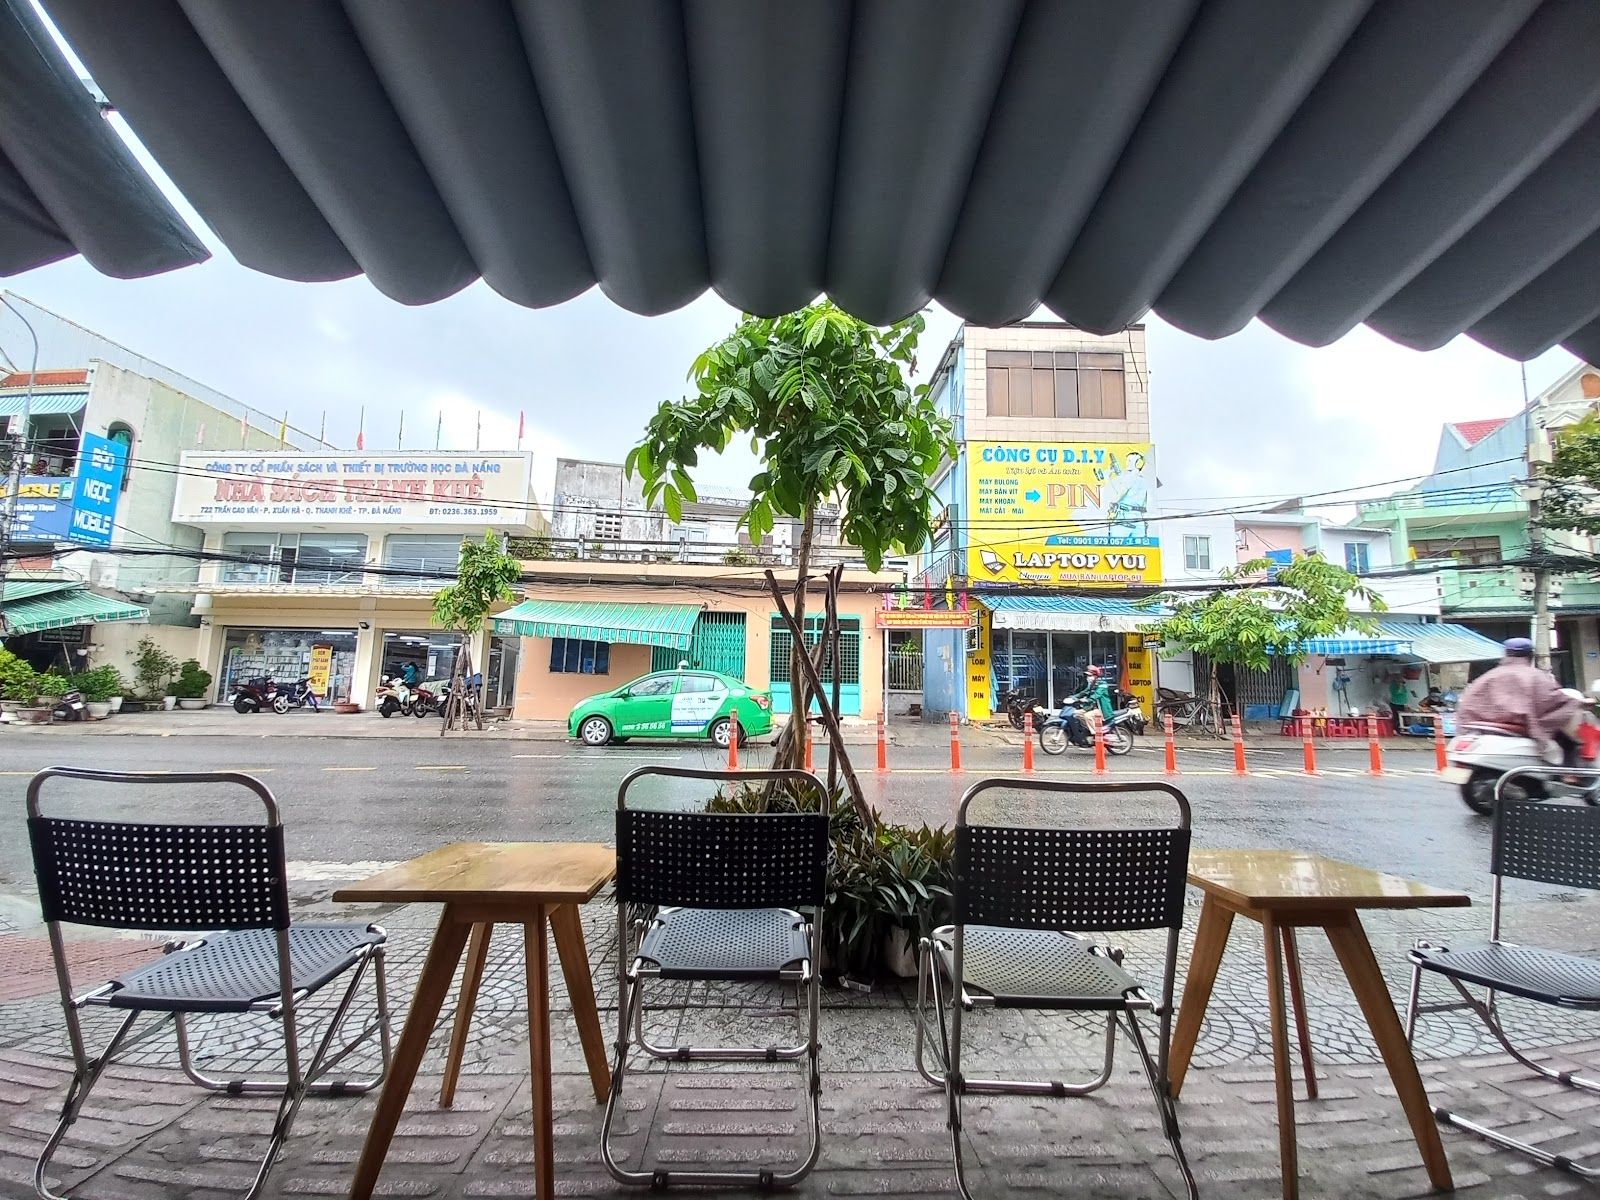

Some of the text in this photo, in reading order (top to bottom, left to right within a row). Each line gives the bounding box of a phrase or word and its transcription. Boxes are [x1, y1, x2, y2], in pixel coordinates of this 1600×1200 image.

[983, 446, 1105, 466] CÔNG CỤ D.I.Y
[205, 461, 232, 472] CÔNG
[234, 463, 247, 472] TY
[250, 459, 264, 473] CỔ
[297, 461, 323, 473] SÁCH
[326, 461, 339, 473] VÀ
[343, 460, 371, 473] THIẾT
[388, 461, 428, 473] TRƯỜNG
[430, 463, 451, 475] HỌC
[214, 473, 485, 503] NHÀ SÁCH THANH KHÊ
[1047, 483, 1102, 510] PIN
[200, 506, 213, 514] 722
[231, 506, 246, 514] CAO
[442, 508, 498, 516] 0236.363.1959
[74, 508, 113, 535] MOBILE
[1057, 537, 1072, 545] Tel:
[1072, 537, 1093, 545] 0901
[1093, 538, 1109, 546] 979
[1014, 552, 1147, 570] LAPTOP VUI
